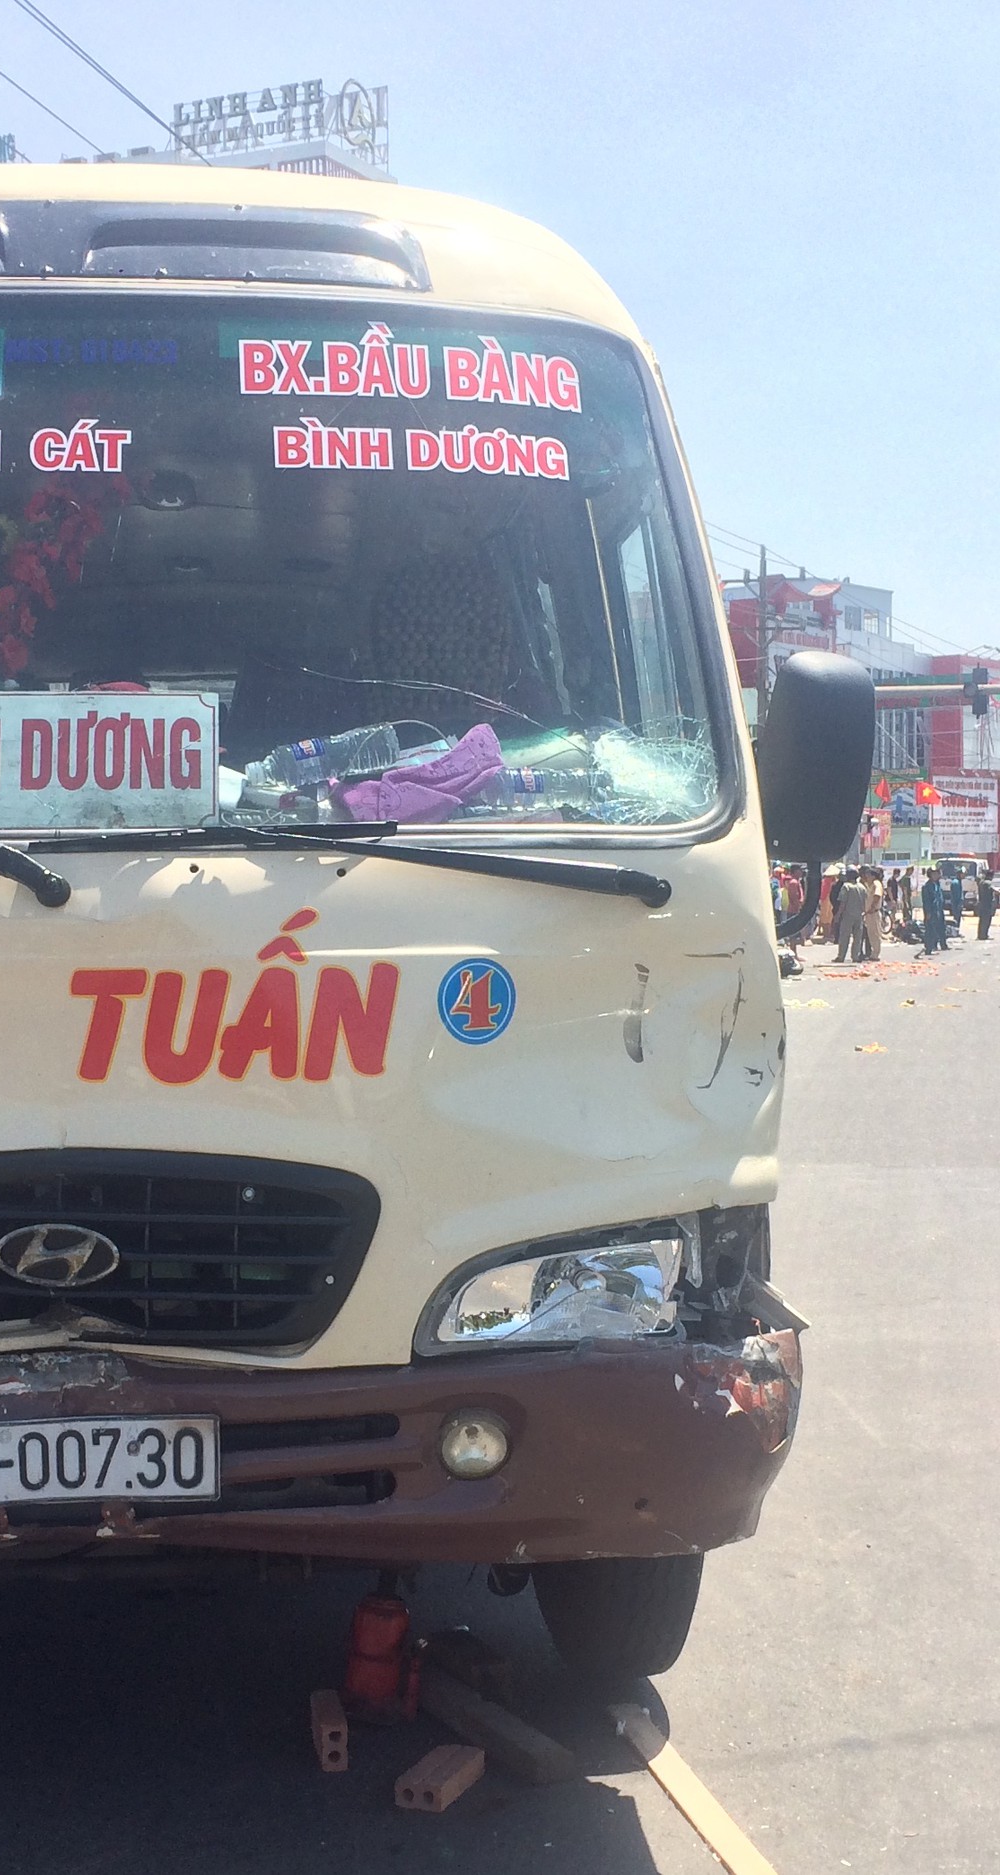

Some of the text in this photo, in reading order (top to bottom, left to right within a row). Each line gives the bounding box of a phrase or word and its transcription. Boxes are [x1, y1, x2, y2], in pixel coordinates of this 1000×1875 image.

[173, 91, 248, 127] LINH
[256, 78, 324, 113] ANH
[238, 321, 582, 413] BX.BẦU BÀNG
[30, 419, 132, 472] CÁT
[273, 417, 570, 481] BÌNH DƯƠNG
[21, 711, 202, 791] DƯƠNG
[70, 906, 400, 1085] TUẤN
[448, 966, 500, 1030] 4
